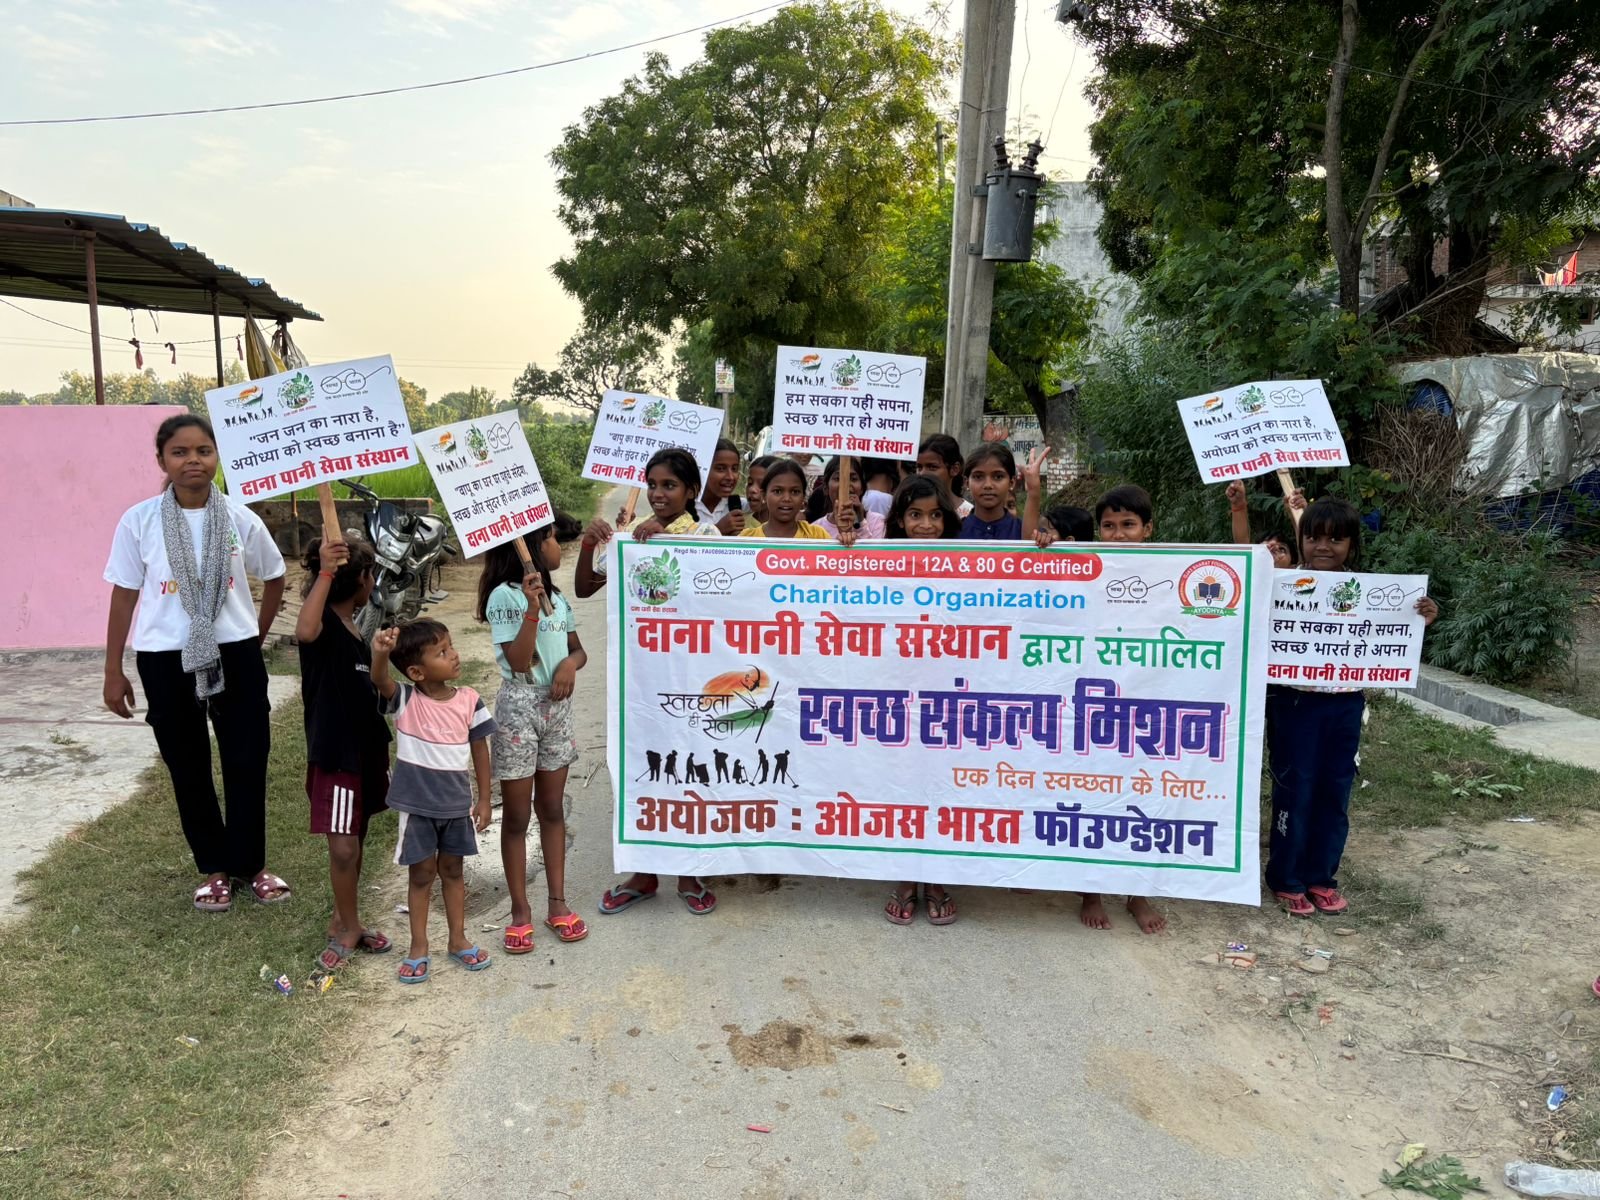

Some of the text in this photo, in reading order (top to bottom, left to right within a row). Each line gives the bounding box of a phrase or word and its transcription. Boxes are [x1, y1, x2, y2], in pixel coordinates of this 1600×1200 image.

[785, 392, 914, 415] हम सबका यही सपना,
[282, 422, 306, 438] जन
[309, 415, 329, 431] का
[331, 411, 362, 427] नारा
[362, 405, 380, 423] है,
[784, 412, 910, 432] स्वच्छ भारत हो अपना
[1241, 422, 1261, 437] जन
[1264, 419, 1280, 431] का
[1280, 418, 1303, 429] नारा
[231, 448, 280, 472] अयोध्या
[282, 439, 302, 458] को
[304, 433, 341, 452] स्वच्छ
[344, 426, 387, 443] बनाना
[625, 434, 635, 444] का
[782, 432, 914, 455] दाना पानी सेवा संस्थान
[1201, 444, 1241, 461] अयोध्या
[1243, 436, 1260, 452] को
[1259, 433, 1289, 446] स्वच्छ
[1291, 430, 1323, 443] बनाना
[593, 445, 611, 457] स्वच्छ
[611, 446, 624, 459] और
[640, 451, 649, 463] हो
[1209, 447, 1343, 479] दाना पानी सेवा संस्थान
[240, 446, 410, 497] दाना पानी सेवा संस्थान
[591, 462, 613, 478] दाना
[614, 465, 636, 480] पानी
[471, 478, 483, 491] का
[452, 507, 471, 524] स्वच्छ
[471, 499, 486, 517] और
[499, 490, 509, 506] हो
[465, 502, 551, 548] दाना पानी सेवा संस्थान
[765, 553, 810, 570] Govt.
[815, 554, 907, 574] Registered
[922, 556, 954, 573] 12A
[958, 556, 971, 573] &
[976, 557, 996, 574] 80
[1001, 557, 1015, 574] G
[1020, 558, 1093, 575] Certified
[769, 583, 1086, 612] Charitable Organization
[1193, 607, 1225, 616] AYODHYA
[635, 610, 1225, 671] दाना पानी सेवा संस्थान द्वारा संचालित
[1273, 619, 1413, 638] हम सबका यही सपना,
[1271, 640, 1309, 654] स्वच्छ
[1354, 640, 1369, 658] हो
[1371, 644, 1408, 657] अपना
[1267, 663, 1412, 682] दाना पानी सेवा संस्थान
[657, 692, 734, 718] स्वच्छता
[688, 711, 701, 728] ही
[702, 714, 737, 741] सेवा
[798, 677, 1229, 760] स्वच्छ संकल्प मिशन
[952, 760, 1227, 800] एक दिन स्वच्छता के लिए...
[635, 790, 778, 835] अयोजक
[815, 791, 929, 840] ओजस
[937, 804, 1023, 844] भारत
[1033, 801, 1218, 856] फॉउण्डेशन
